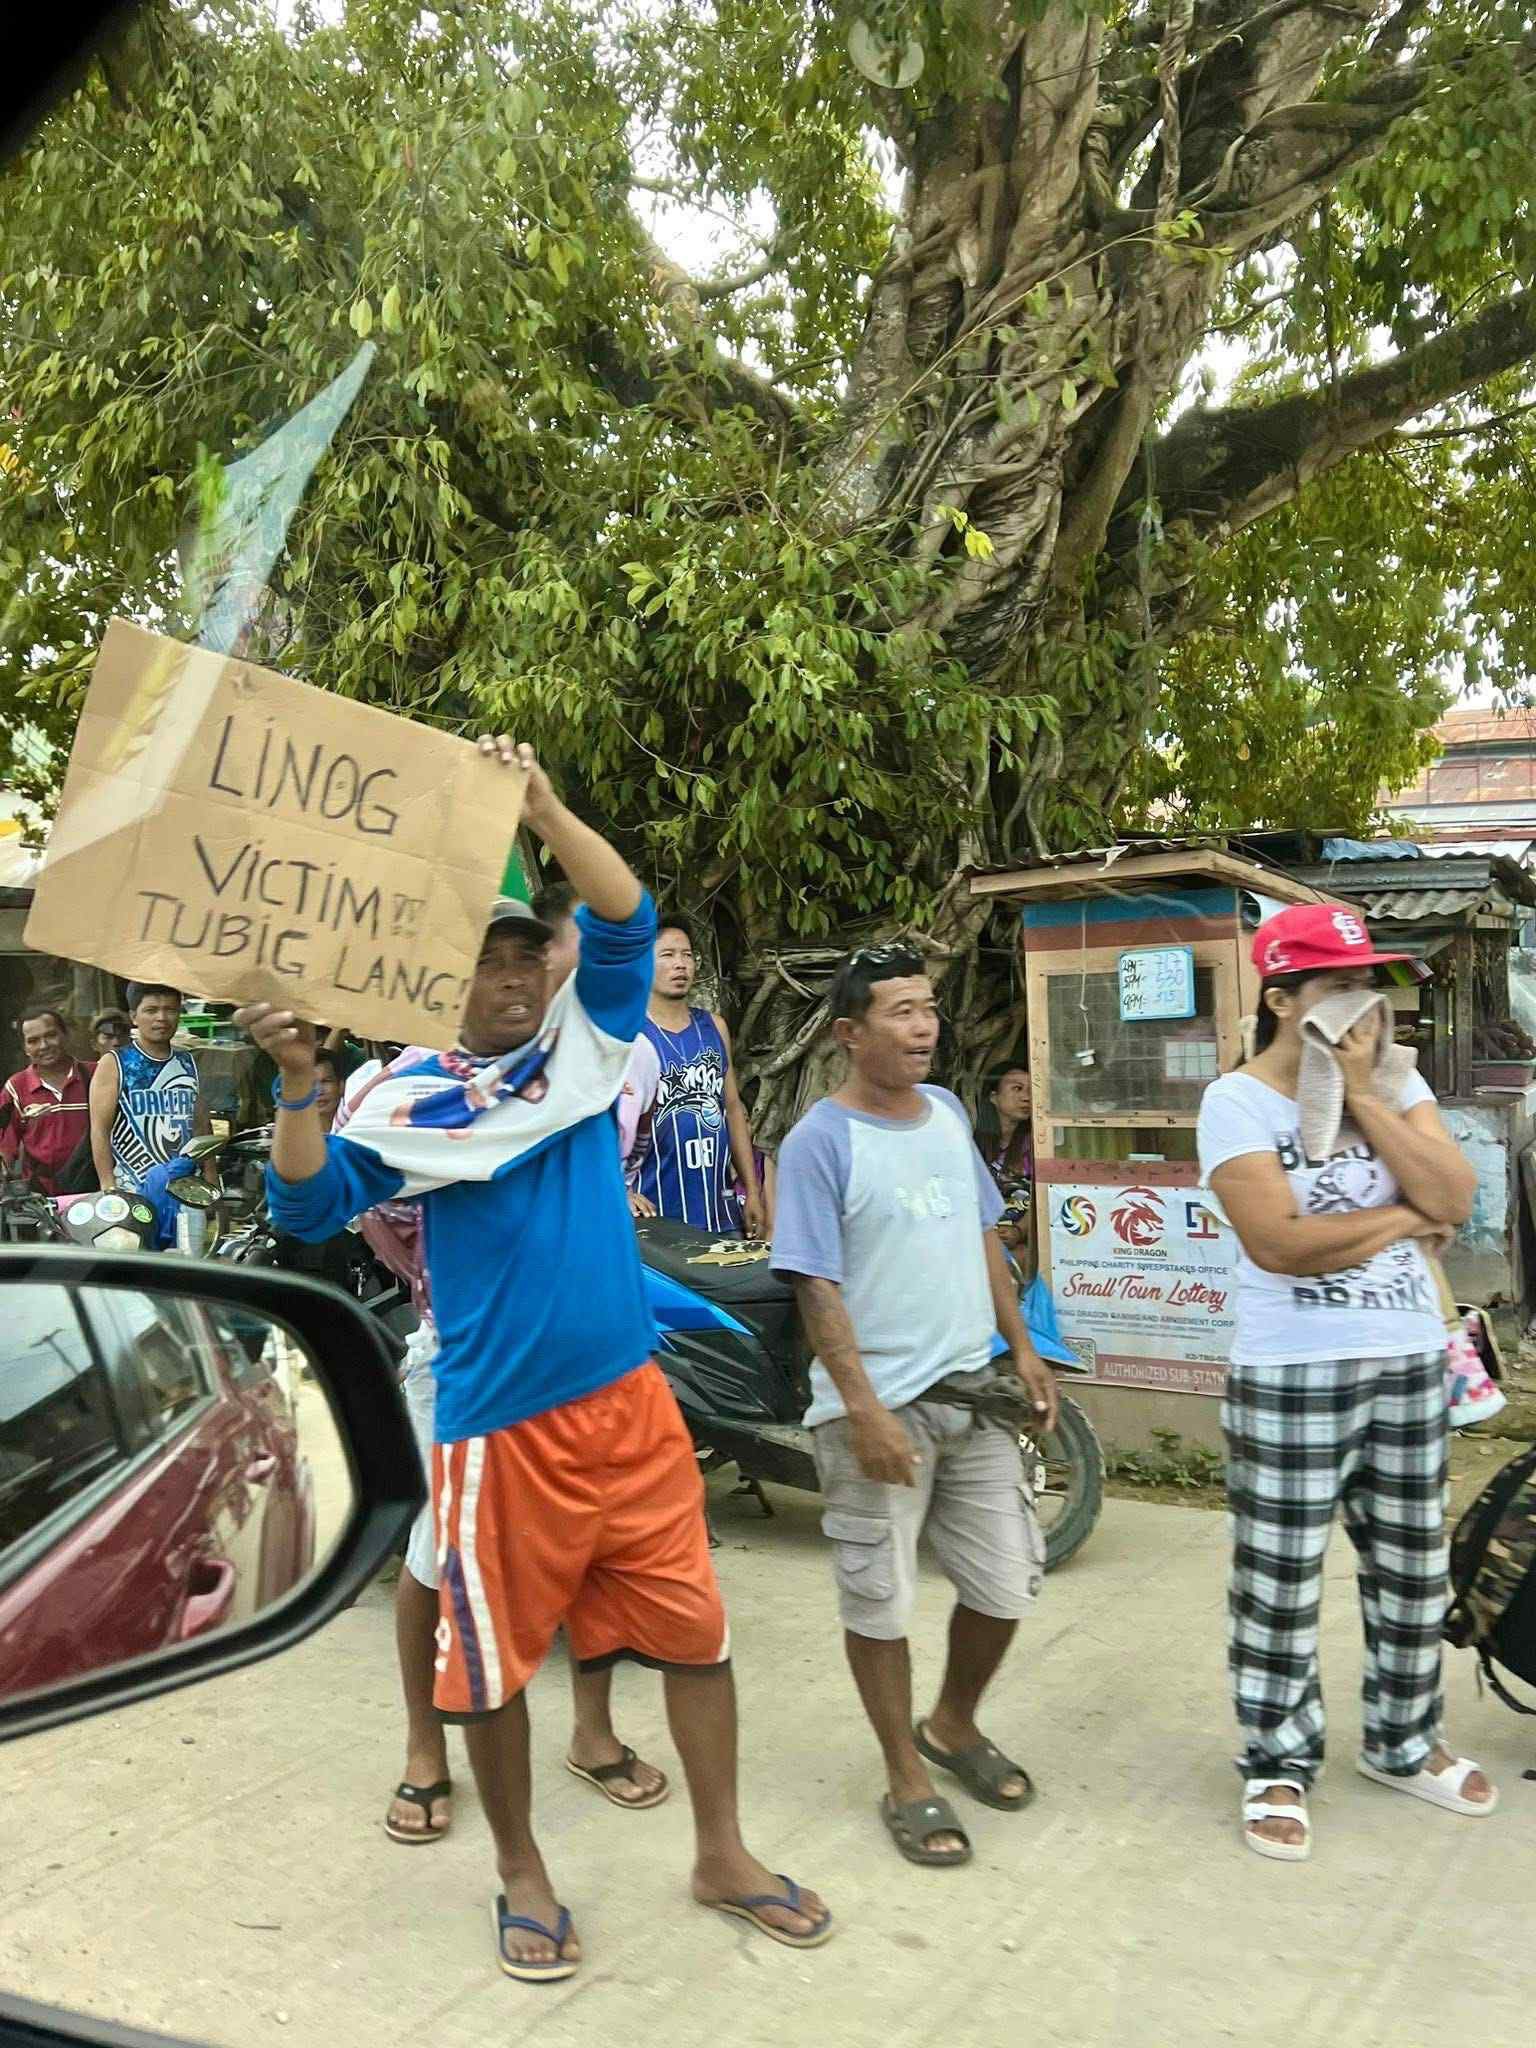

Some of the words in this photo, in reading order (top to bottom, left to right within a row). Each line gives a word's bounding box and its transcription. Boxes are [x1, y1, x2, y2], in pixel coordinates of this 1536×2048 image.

[1133, 1248, 1167, 1258] DRAGON
[1137, 1262, 1197, 1274] SWEEPSTAKES
[1198, 1266, 1228, 1276] OFFICE
[1062, 1272, 1117, 1298] Small
[1118, 1275, 1162, 1300] Town
[1165, 1279, 1228, 1313] Lottery
[1103, 1361, 1169, 1382] AUTHORIZED
